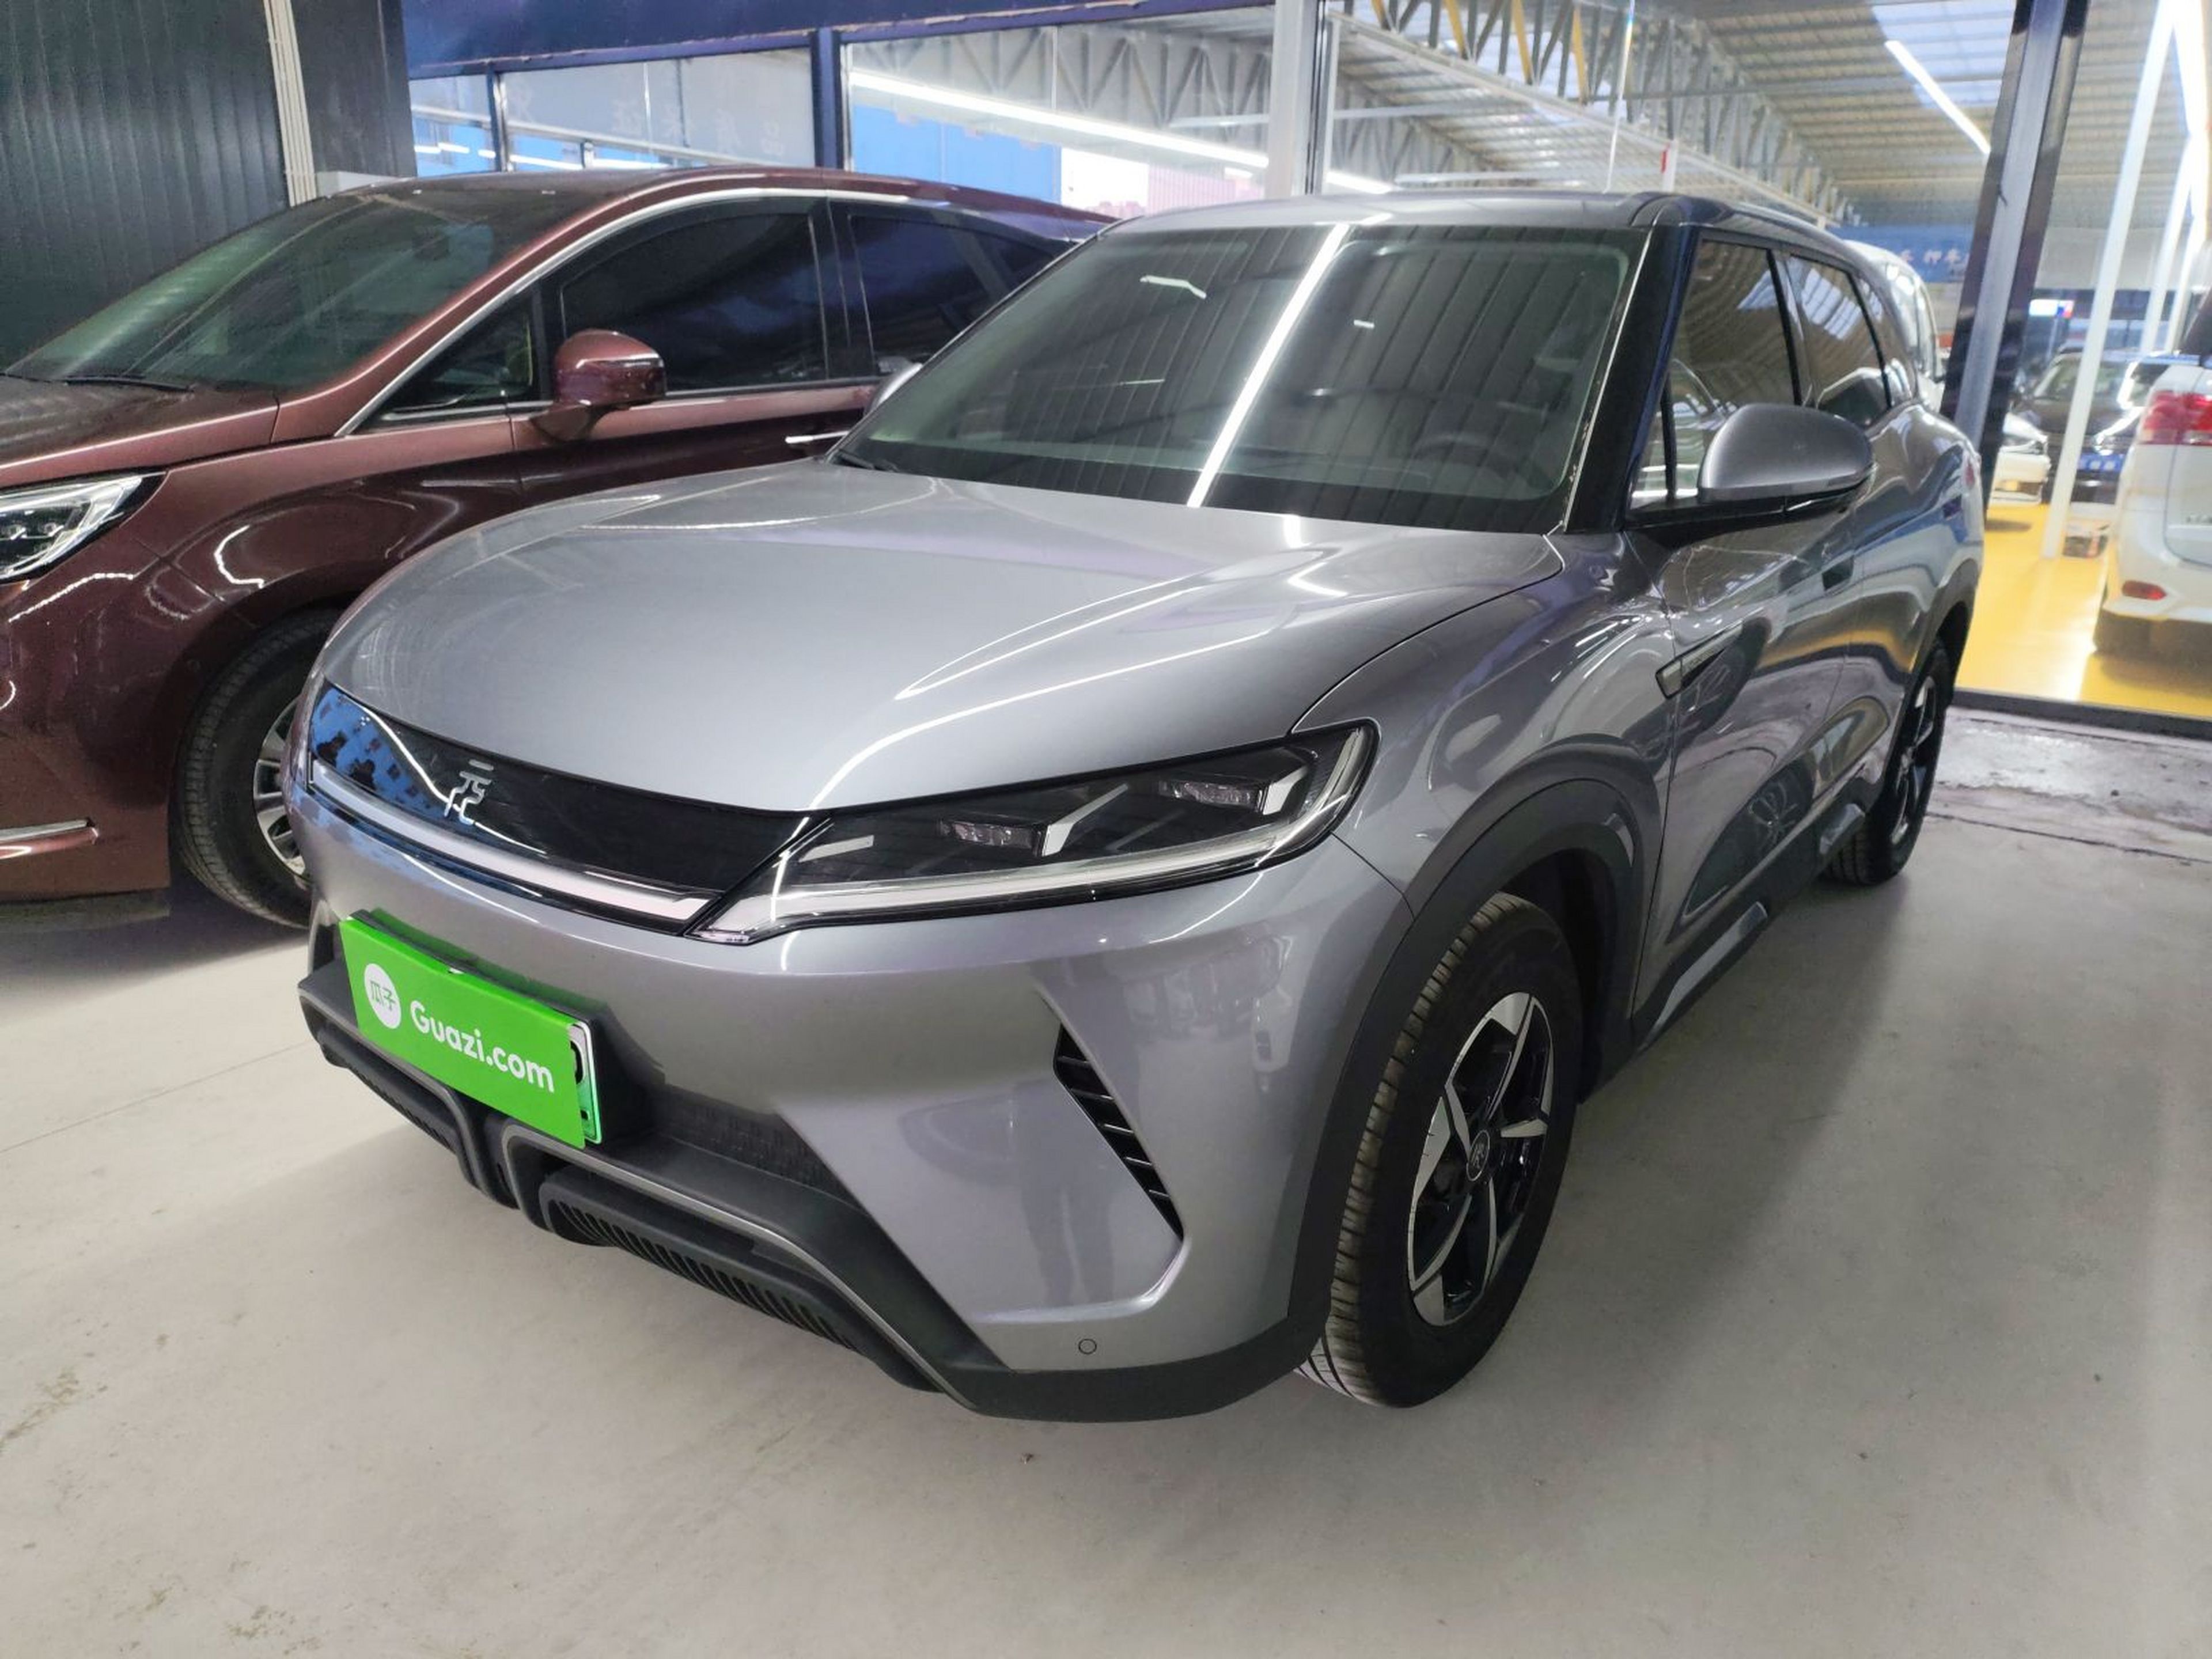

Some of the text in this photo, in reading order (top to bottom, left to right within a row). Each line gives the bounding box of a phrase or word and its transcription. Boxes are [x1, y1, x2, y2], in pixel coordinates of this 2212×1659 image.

[444, 759, 494, 825] 元
[369, 979, 396, 1012] 瓜子
[410, 1000, 555, 1093] Guazi.com
